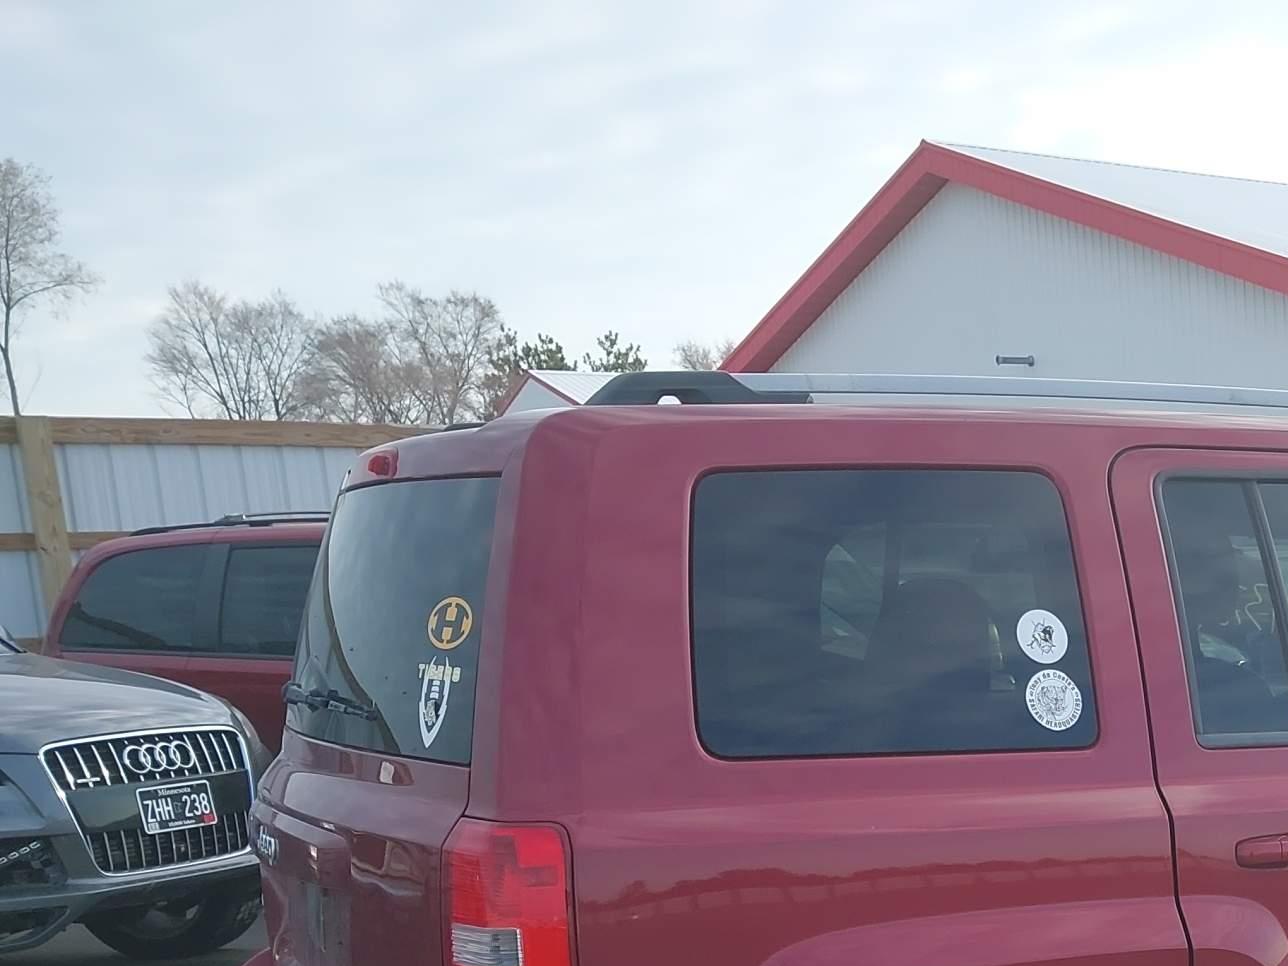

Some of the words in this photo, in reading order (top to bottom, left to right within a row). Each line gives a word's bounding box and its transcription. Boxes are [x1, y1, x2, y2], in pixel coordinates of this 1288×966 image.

[1028, 698, 1045, 722] SAFARI
[143, 797, 175, 823] ZHH
[181, 793, 211, 818] 238
